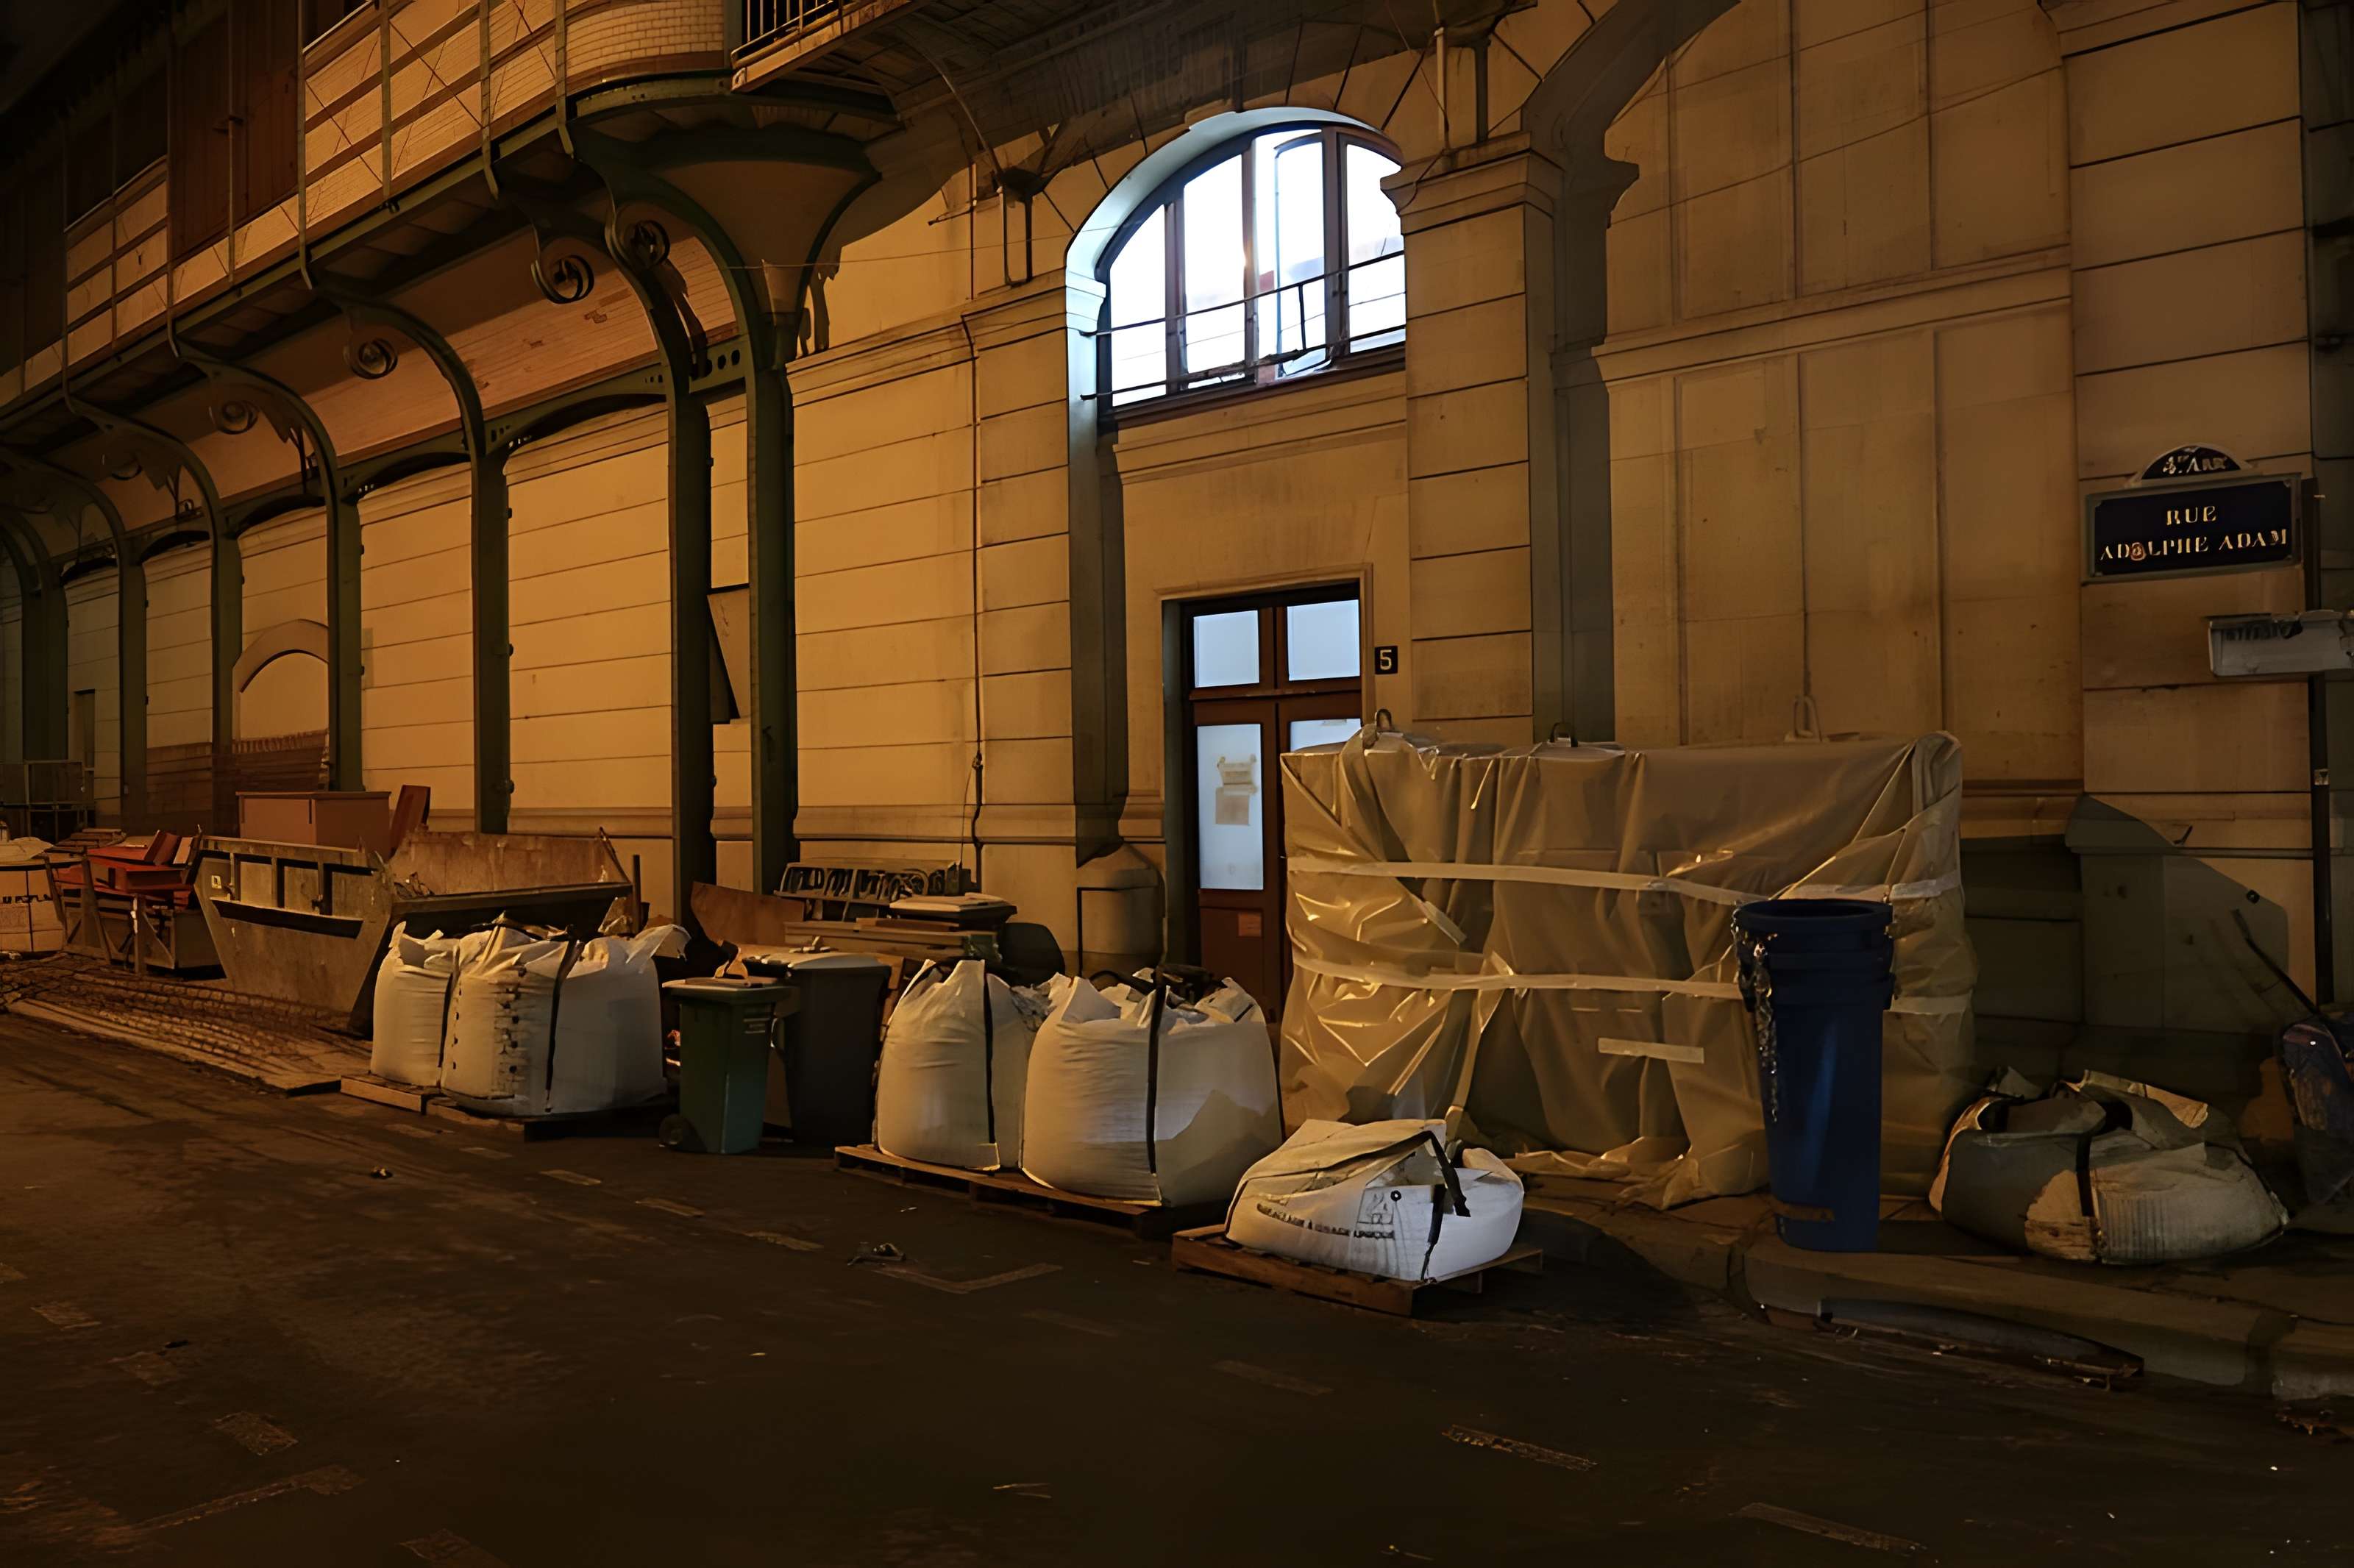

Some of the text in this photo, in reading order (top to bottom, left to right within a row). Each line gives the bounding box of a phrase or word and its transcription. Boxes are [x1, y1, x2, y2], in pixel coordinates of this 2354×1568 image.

[2166, 505, 2217, 526] RUE
[2219, 528, 2287, 551] ADAM
[1379, 649, 1393, 671] 5
